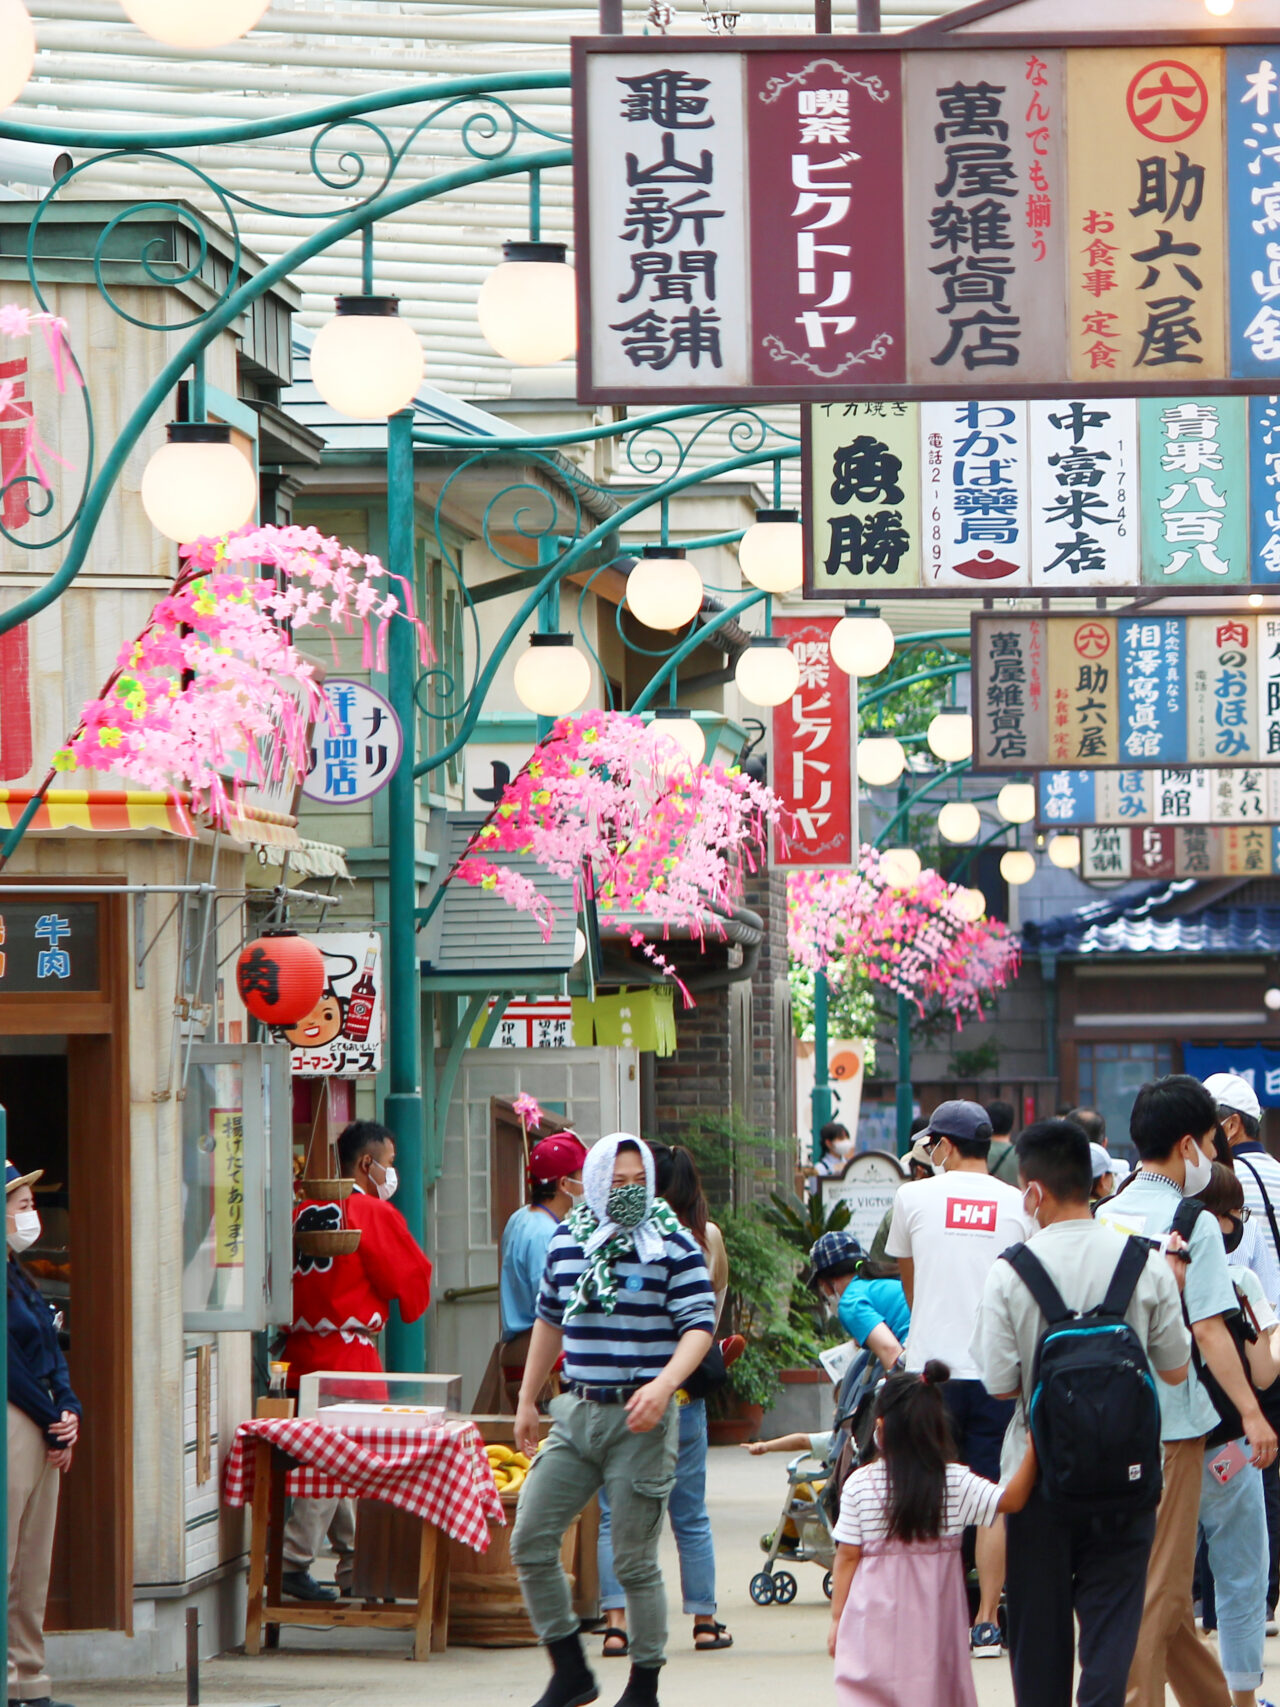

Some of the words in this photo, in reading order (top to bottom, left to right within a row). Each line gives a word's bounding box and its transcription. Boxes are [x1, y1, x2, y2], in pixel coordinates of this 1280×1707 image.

[928, 80, 1021, 371] 萬屋雑貨店
[1025, 55, 1052, 263] なんでも揃う
[1127, 150, 1208, 368] 助六屋
[823, 435, 910, 575] 魚勝
[1042, 402, 1122, 574] 中富米店
[1158, 403, 1231, 575] 青果八百八
[1076, 663, 1108, 758] 助六屋
[1164, 621, 1180, 713] 記念写真なら
[35, 914, 71, 978] 牛肉
